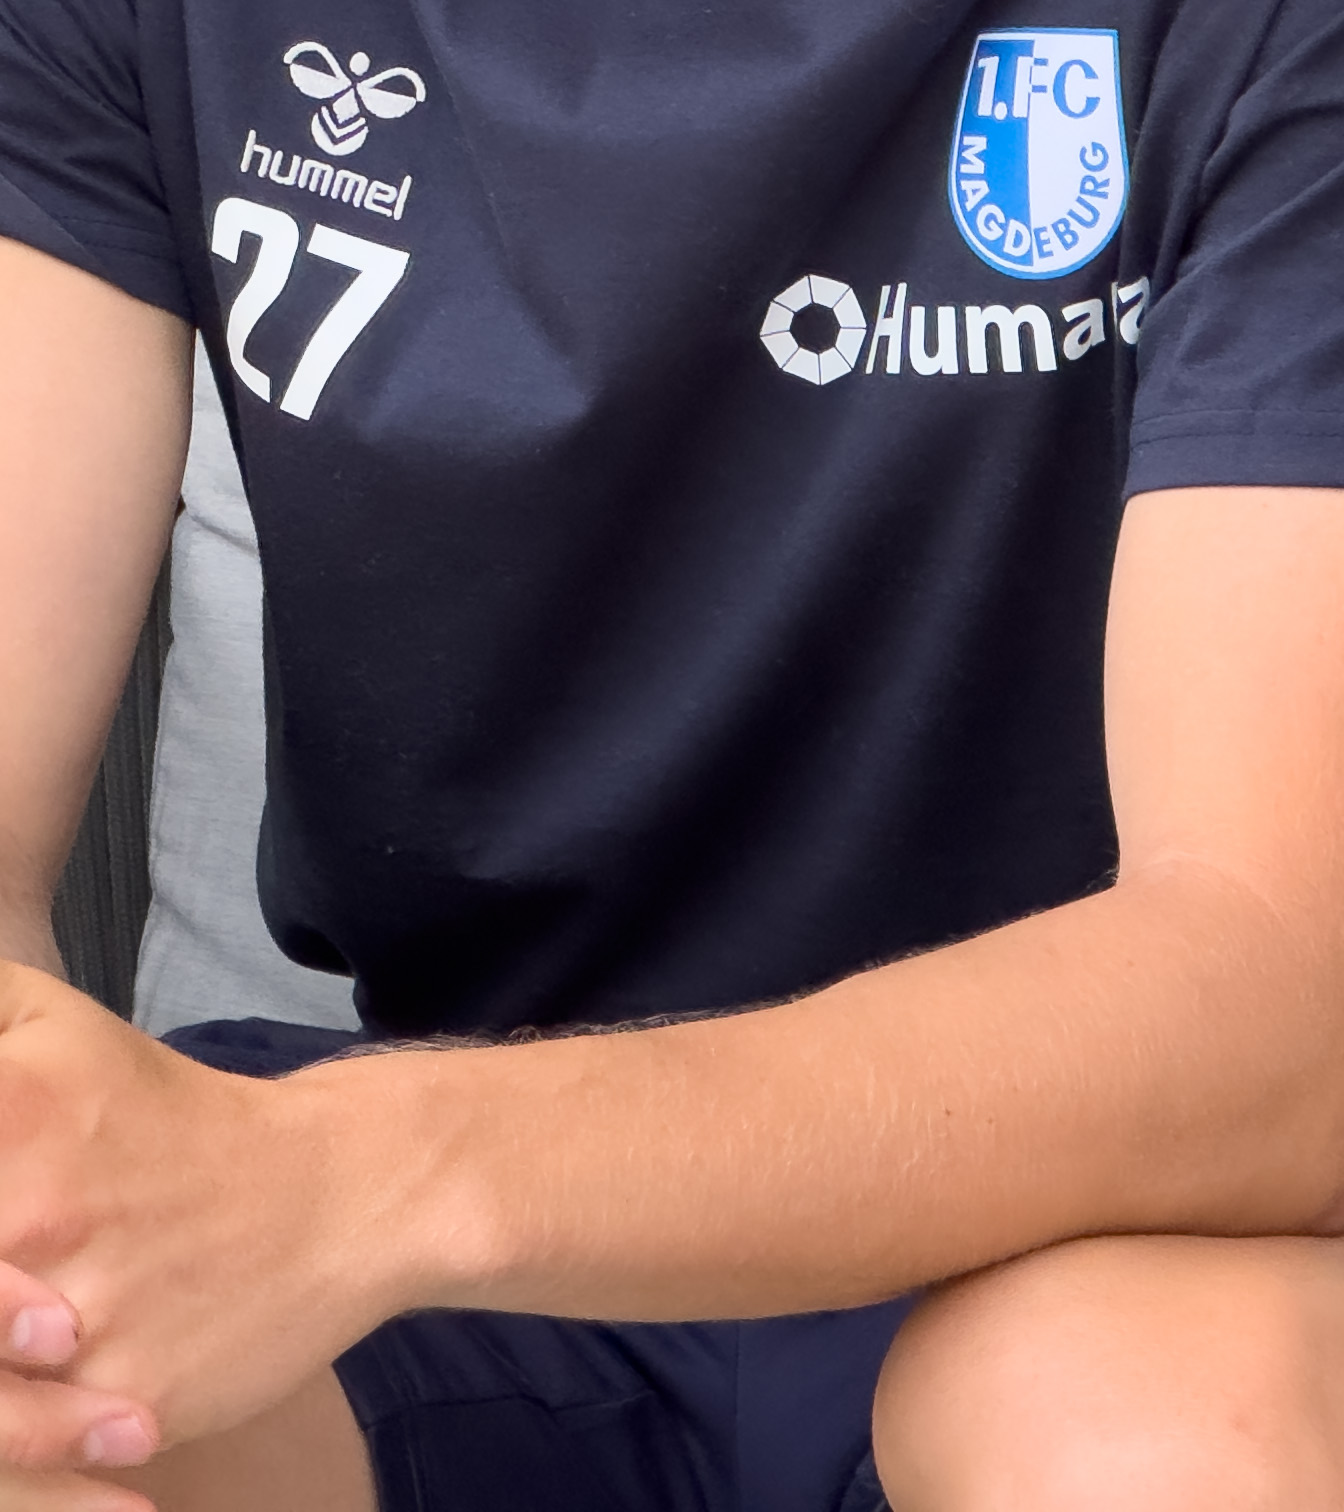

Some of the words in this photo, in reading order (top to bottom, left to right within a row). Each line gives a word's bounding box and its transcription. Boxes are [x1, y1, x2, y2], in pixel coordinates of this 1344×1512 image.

[240, 129, 412, 221] hummel
[959, 135, 1111, 259] MAGDEBURG
[211, 197, 411, 421] 27
